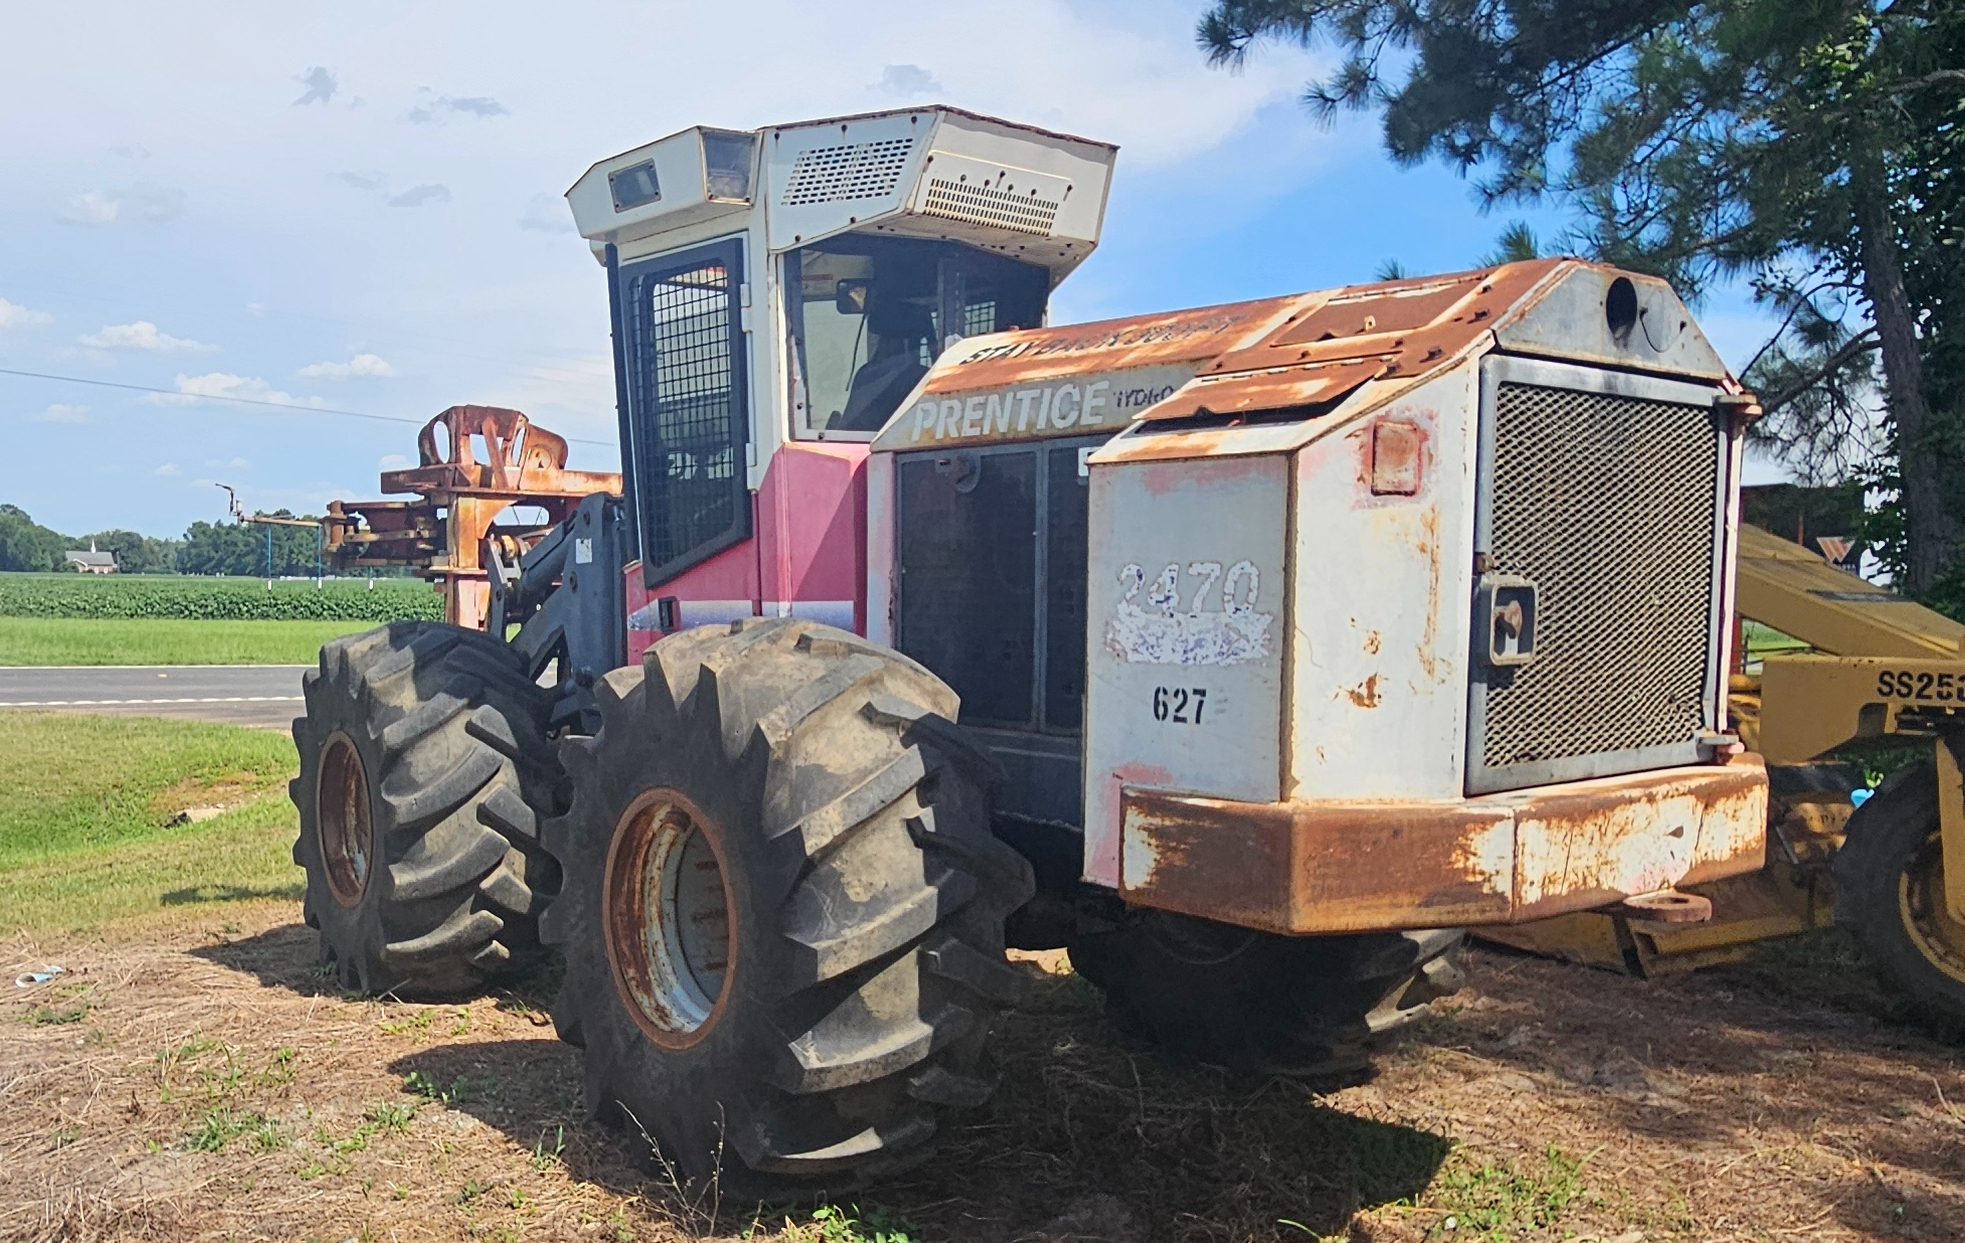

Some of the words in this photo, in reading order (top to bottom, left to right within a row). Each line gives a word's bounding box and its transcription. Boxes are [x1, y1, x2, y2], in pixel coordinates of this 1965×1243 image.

[959, 340, 1041, 365] STAY
[911, 381, 1110, 442] PRENTICE
[1117, 560, 1260, 619] 2470
[1153, 686, 1207, 724] 627
